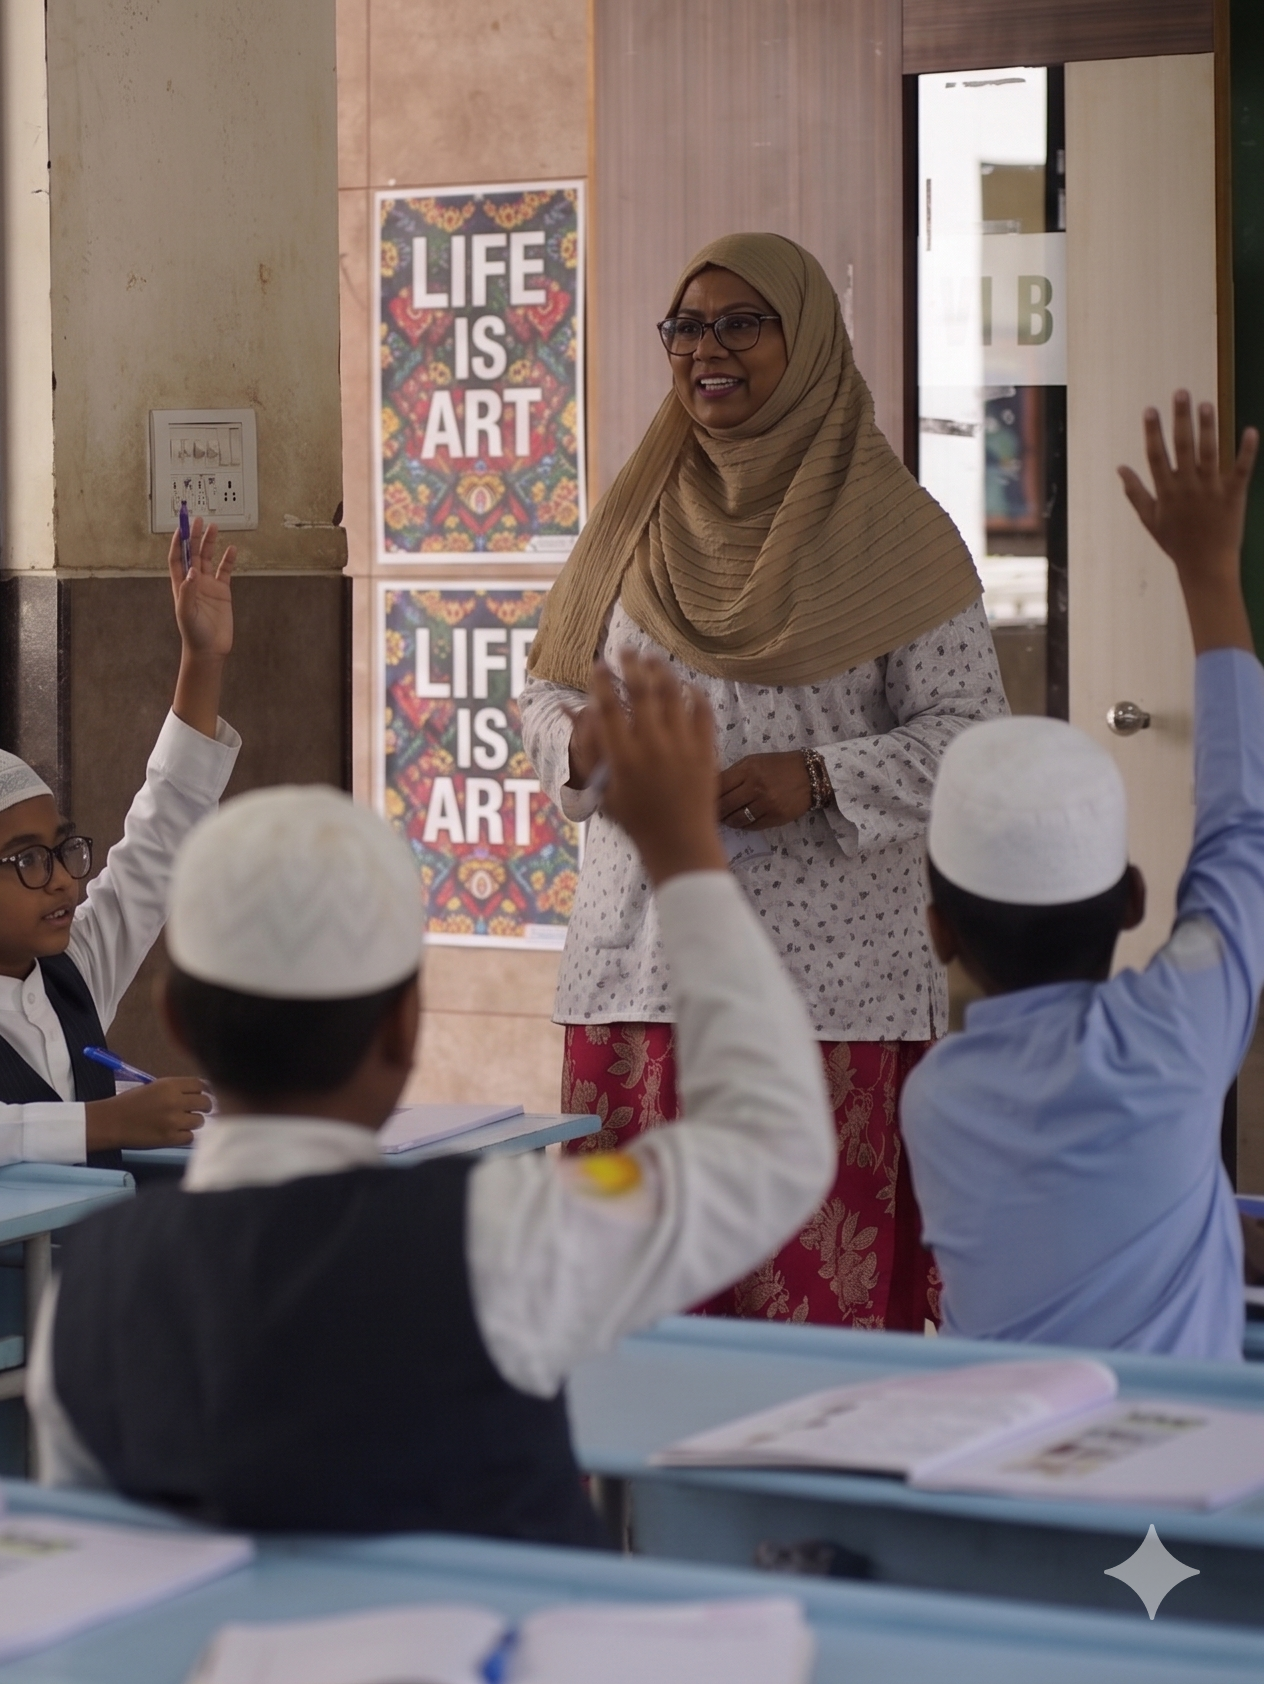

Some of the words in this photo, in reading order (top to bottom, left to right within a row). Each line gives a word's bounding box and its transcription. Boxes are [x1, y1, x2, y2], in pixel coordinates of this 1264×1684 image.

[412, 231, 546, 310] LIFE
[1017, 275, 1054, 346] B
[454, 314, 507, 381] IS
[421, 387, 542, 460] ART
[456, 706, 509, 771] IS
[423, 776, 541, 847] ART
